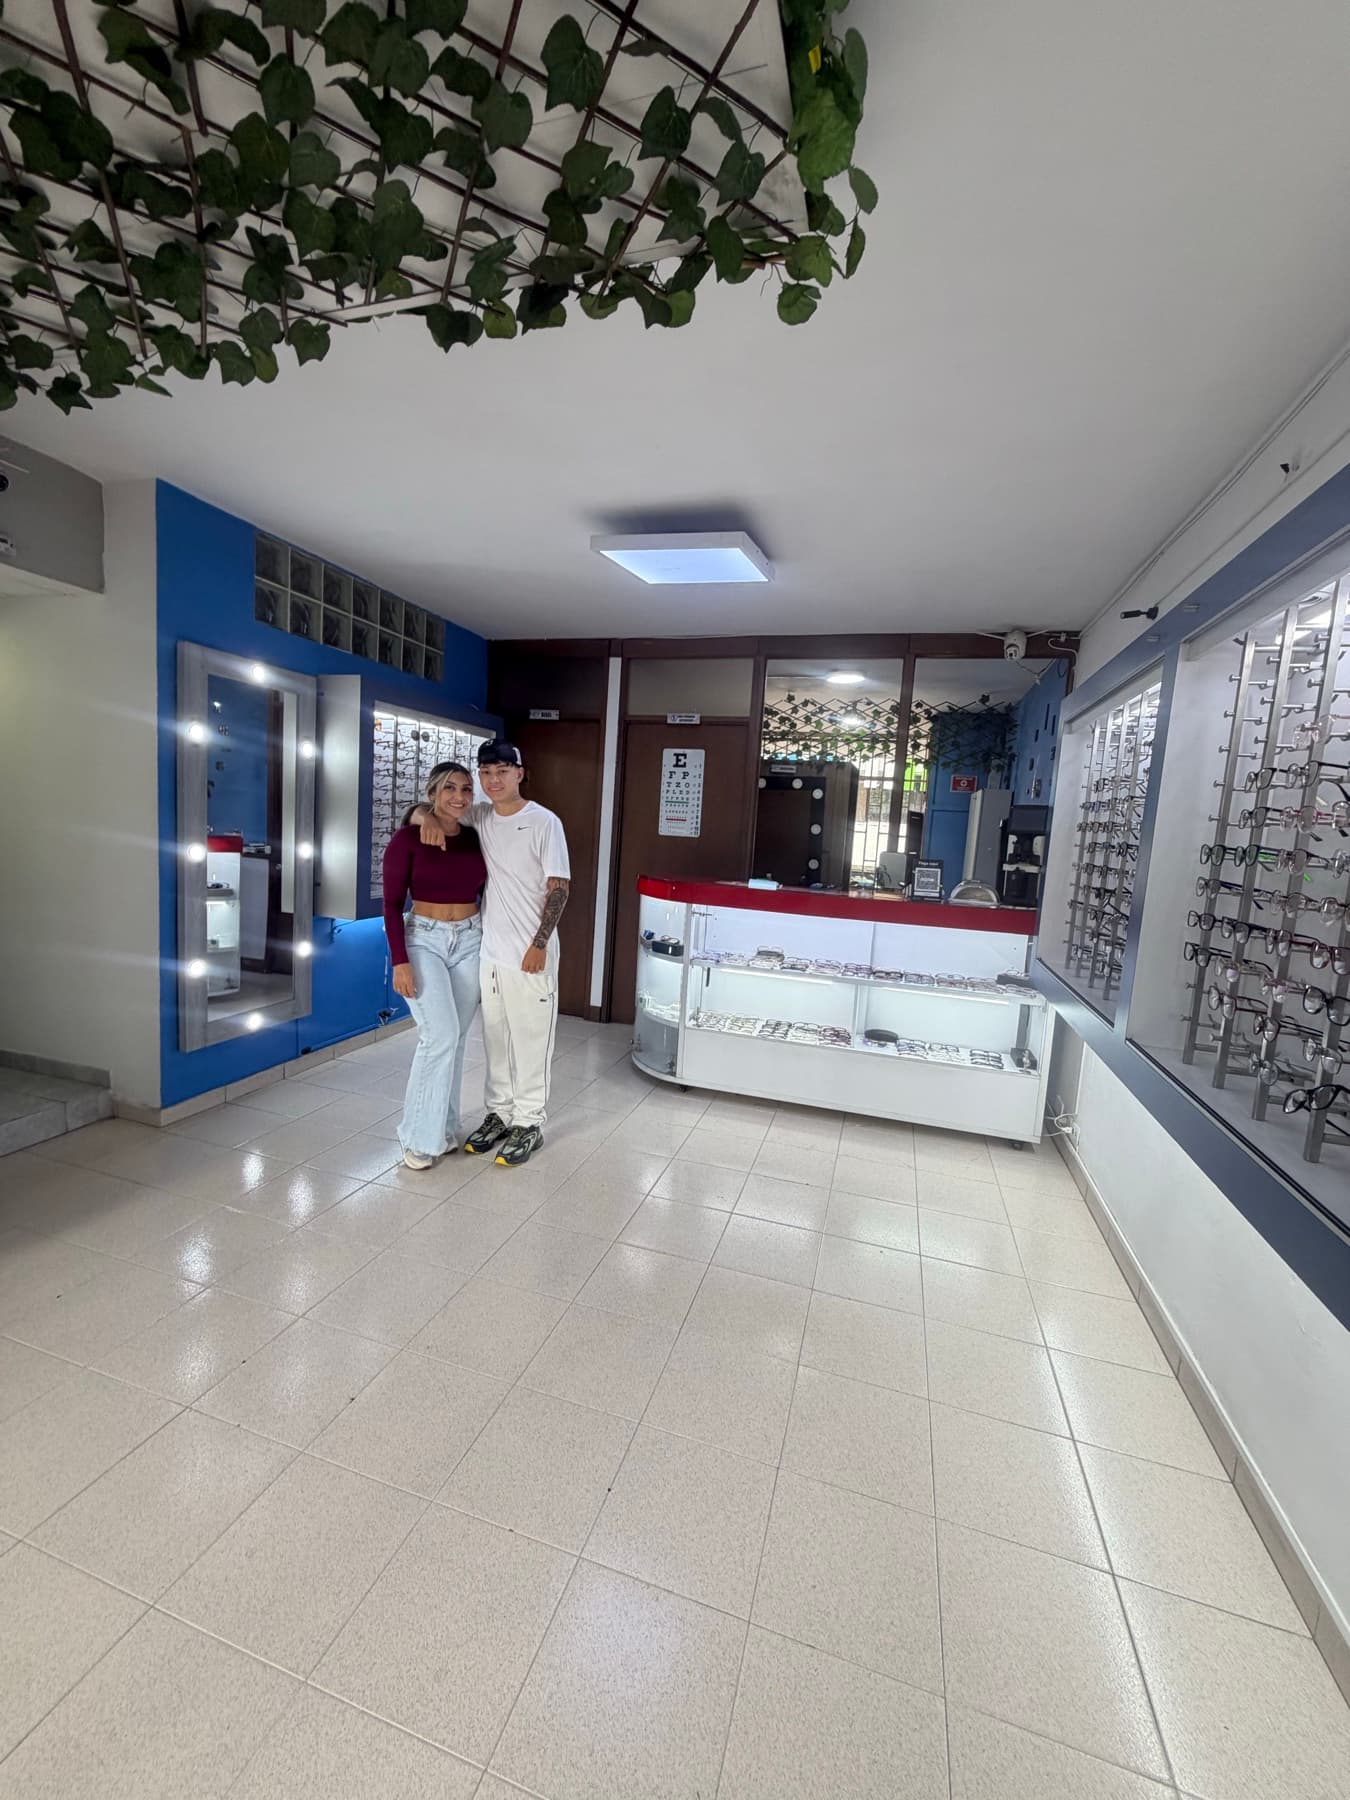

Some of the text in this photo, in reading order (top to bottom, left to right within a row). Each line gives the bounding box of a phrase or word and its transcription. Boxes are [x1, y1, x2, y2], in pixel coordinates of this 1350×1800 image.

[673, 753, 687, 768] E
[669, 771, 690, 779] F P
